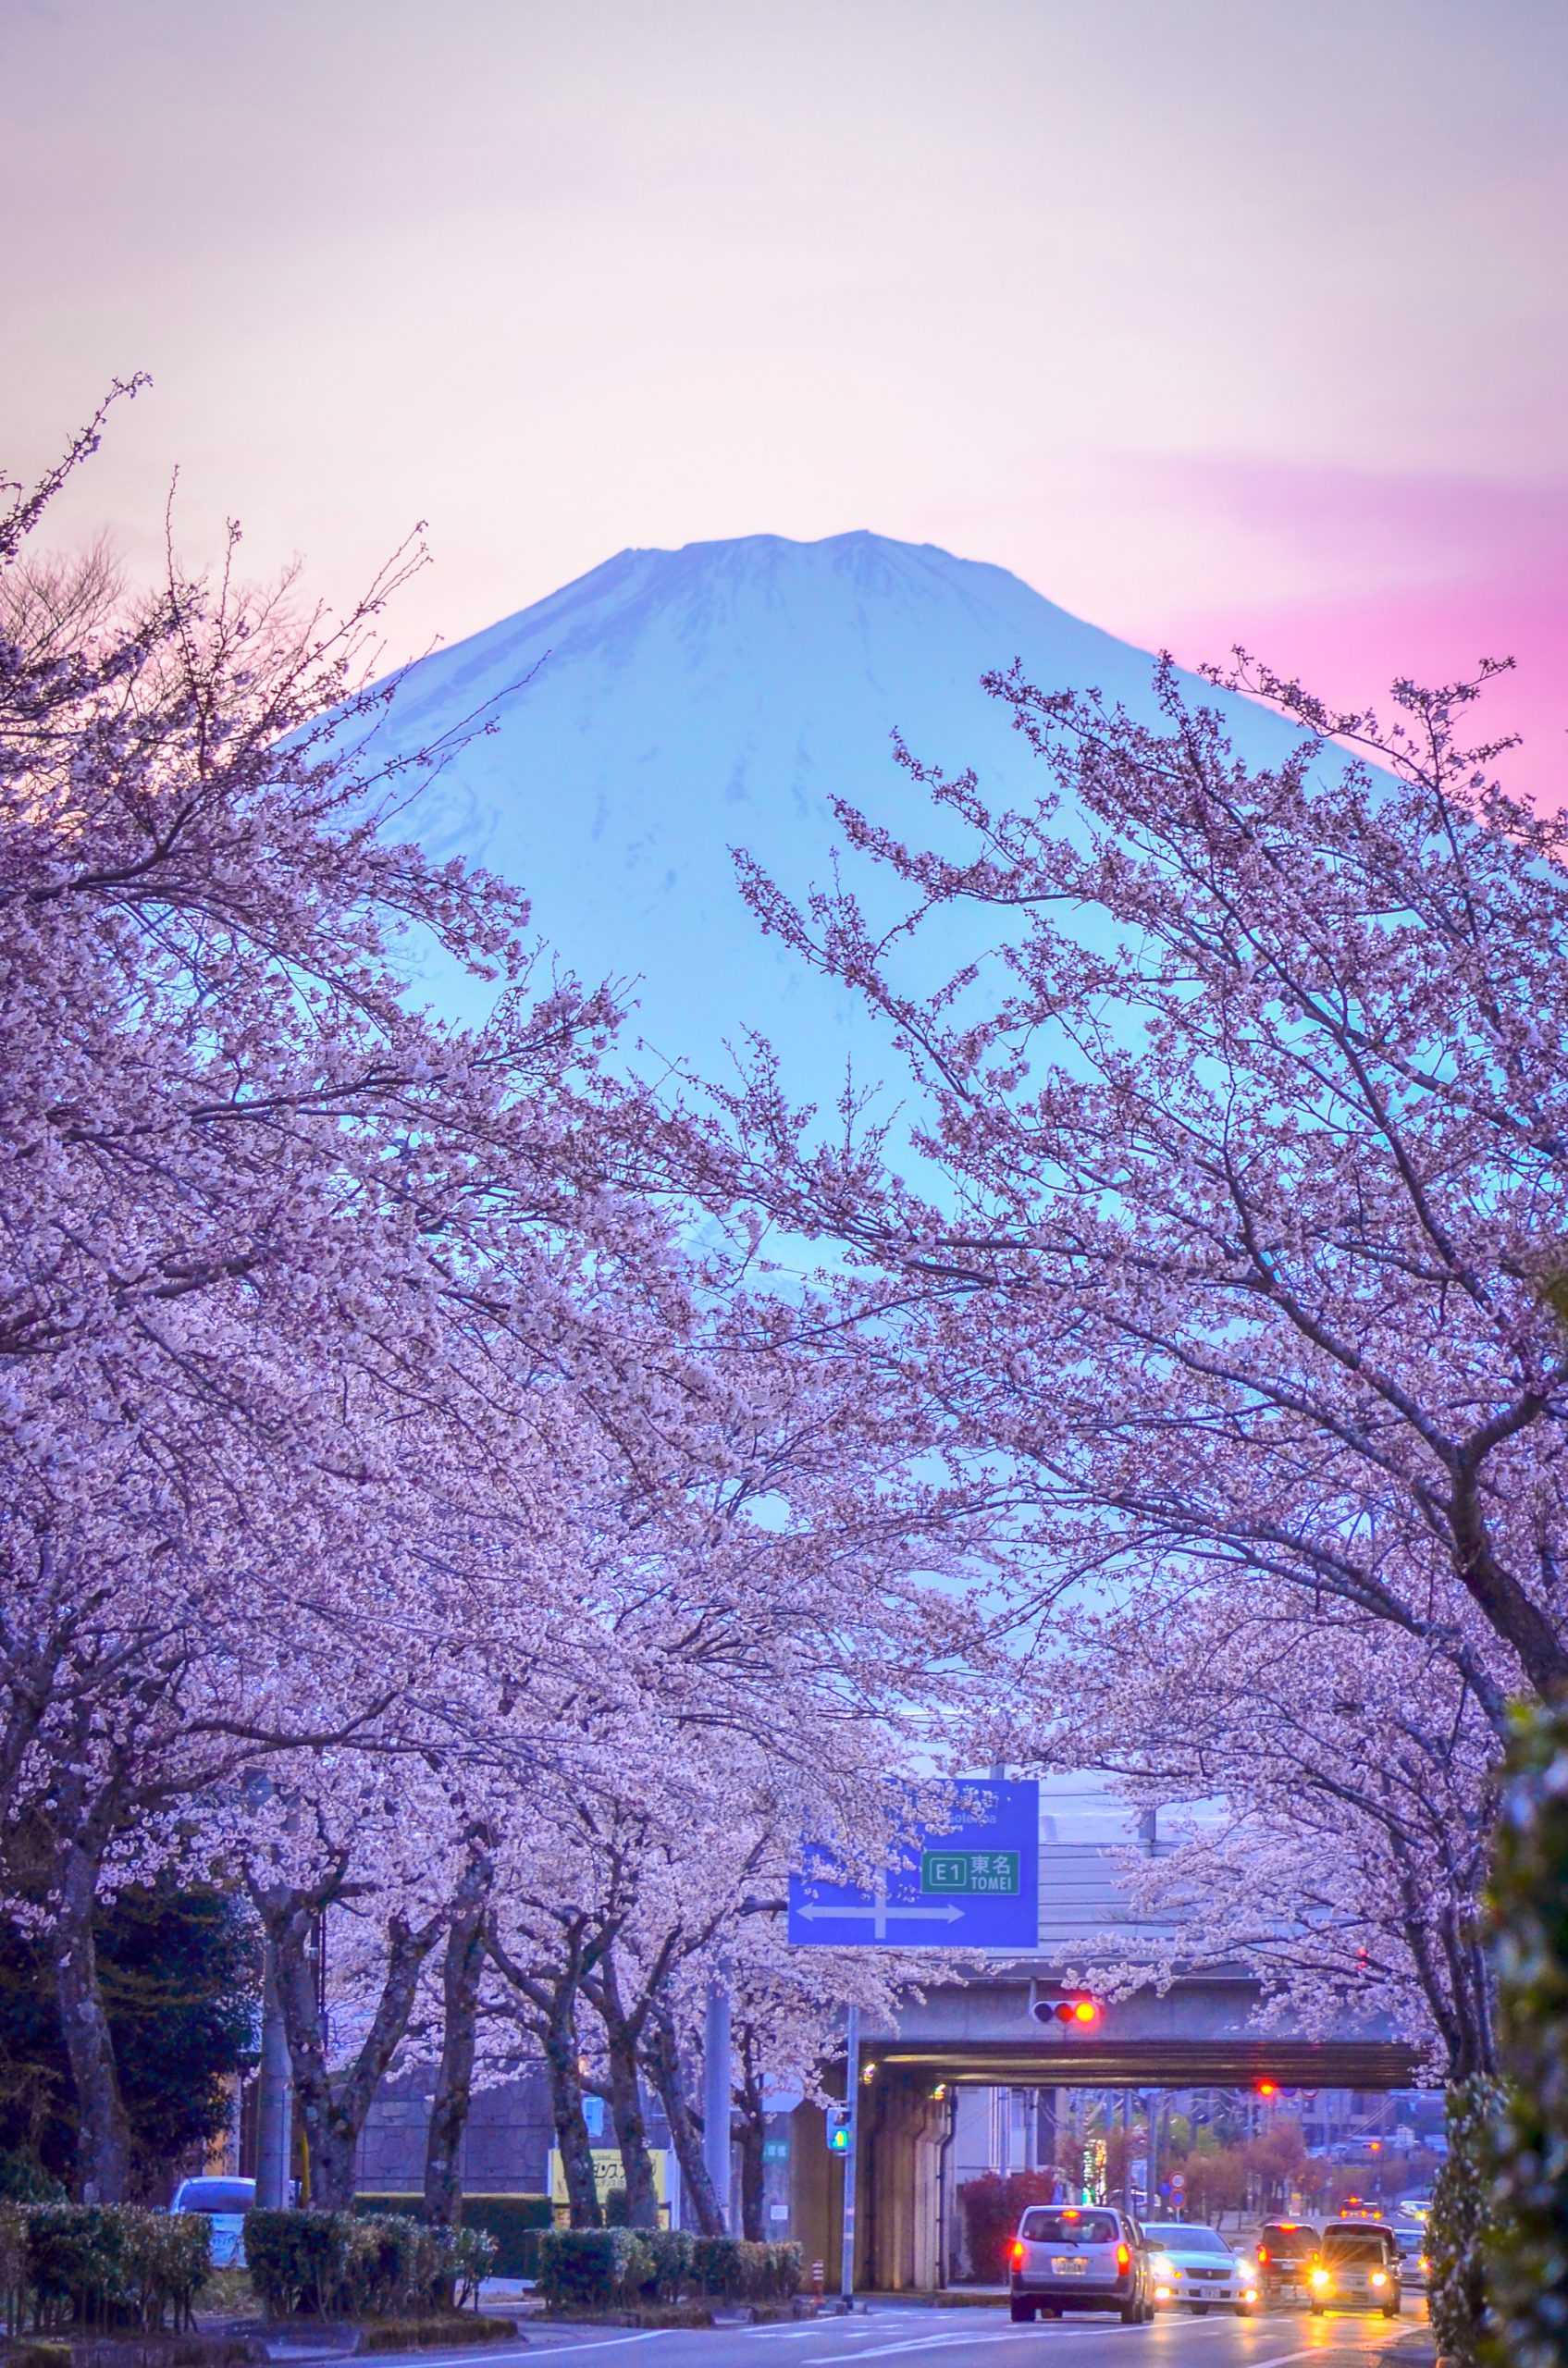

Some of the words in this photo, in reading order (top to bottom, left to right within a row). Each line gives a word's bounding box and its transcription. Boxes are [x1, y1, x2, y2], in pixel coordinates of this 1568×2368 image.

[936, 1864, 958, 1881] E1
[970, 1855, 1010, 1875] 東名
[970, 1877, 1011, 1890] TOMEI
